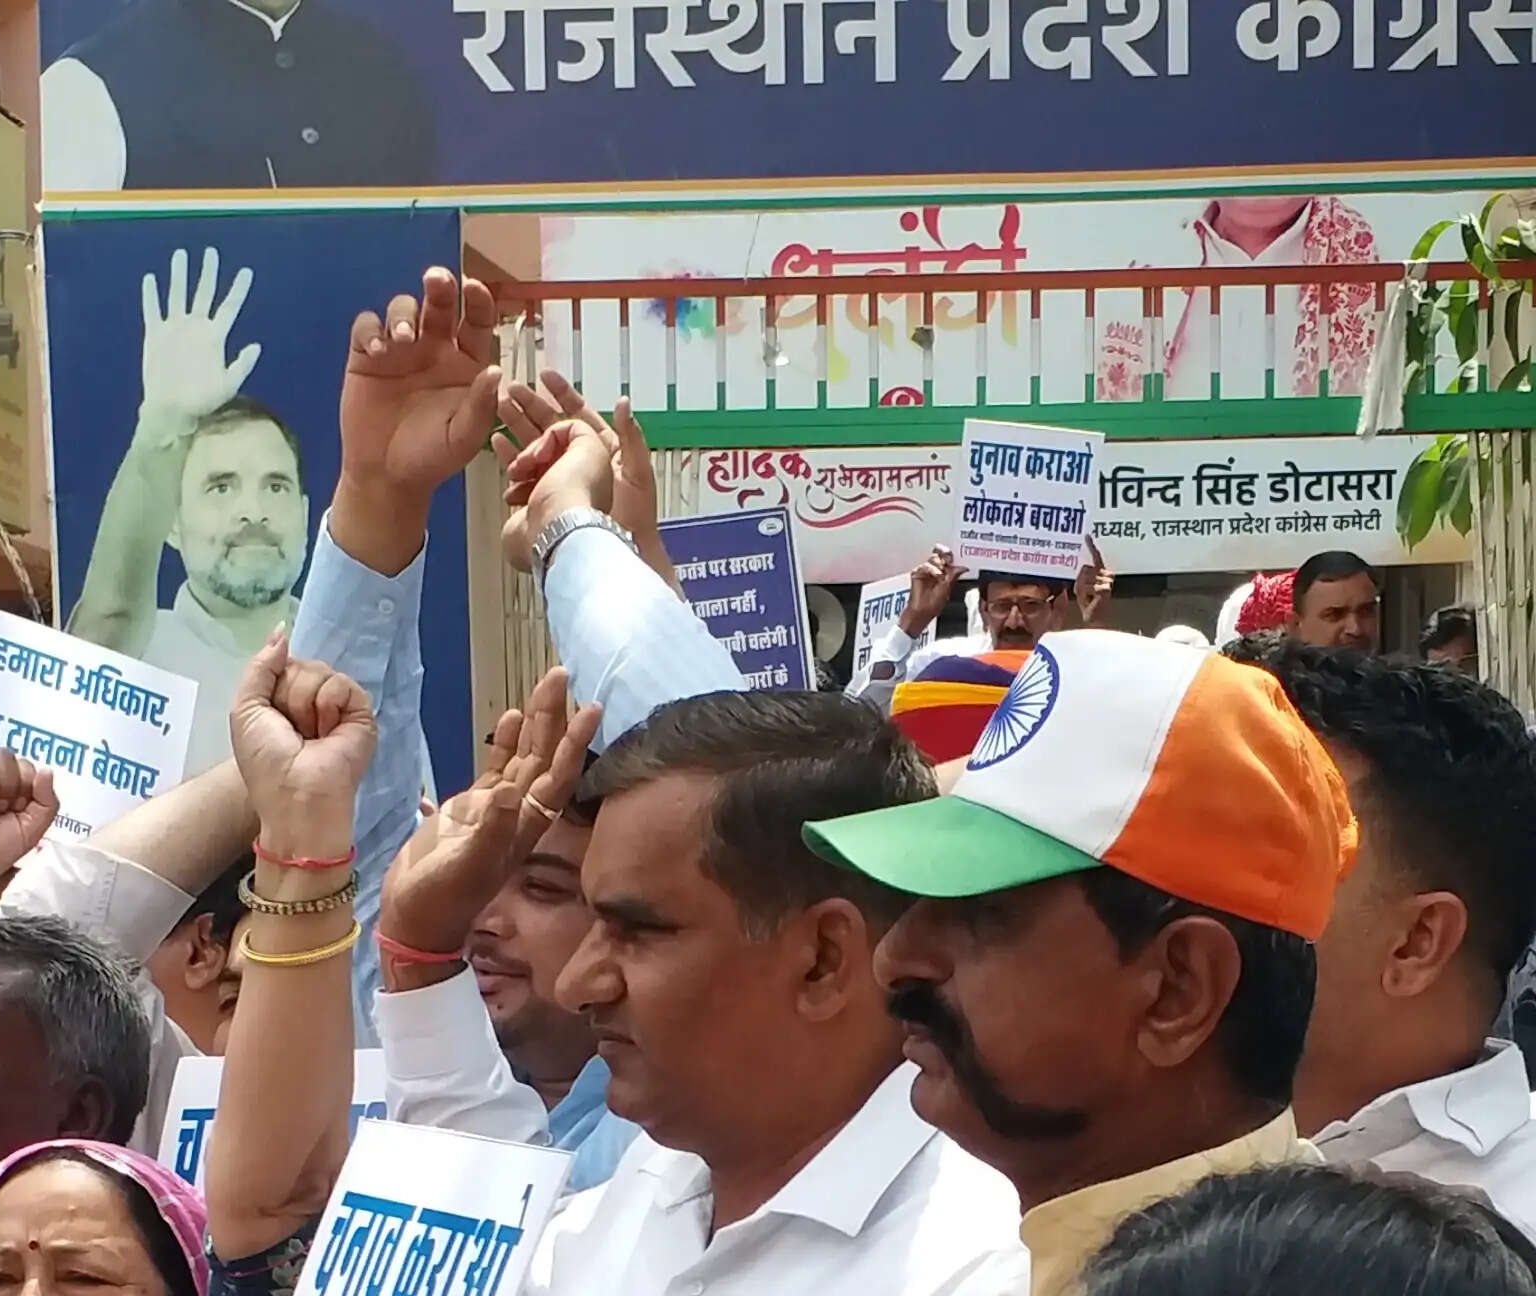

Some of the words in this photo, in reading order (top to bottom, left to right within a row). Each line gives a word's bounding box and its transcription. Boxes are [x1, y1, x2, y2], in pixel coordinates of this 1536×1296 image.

[453, 0, 900, 92] राजस्थान
[969, 440, 1025, 487] चुनाव
[1025, 441, 1094, 485] कराओ
[1099, 464, 1184, 508] ोविन्द
[1192, 456, 1260, 506] सिंह
[1267, 460, 1398, 504] डोटासरा
[962, 489, 1029, 529] लोकतंत्र
[1029, 500, 1087, 535] बचाओ
[1151, 518, 1224, 539] राजस्थान
[1228, 511, 1271, 536] प्रदेश
[1275, 509, 1328, 533] कांग्रेस
[1332, 508, 1383, 532] कमेटी
[729, 552, 775, 576] सरकार
[69, 664, 171, 736] अधिकार,
[6, 717, 90, 776] टालना
[92, 739, 161, 800] बेकार
